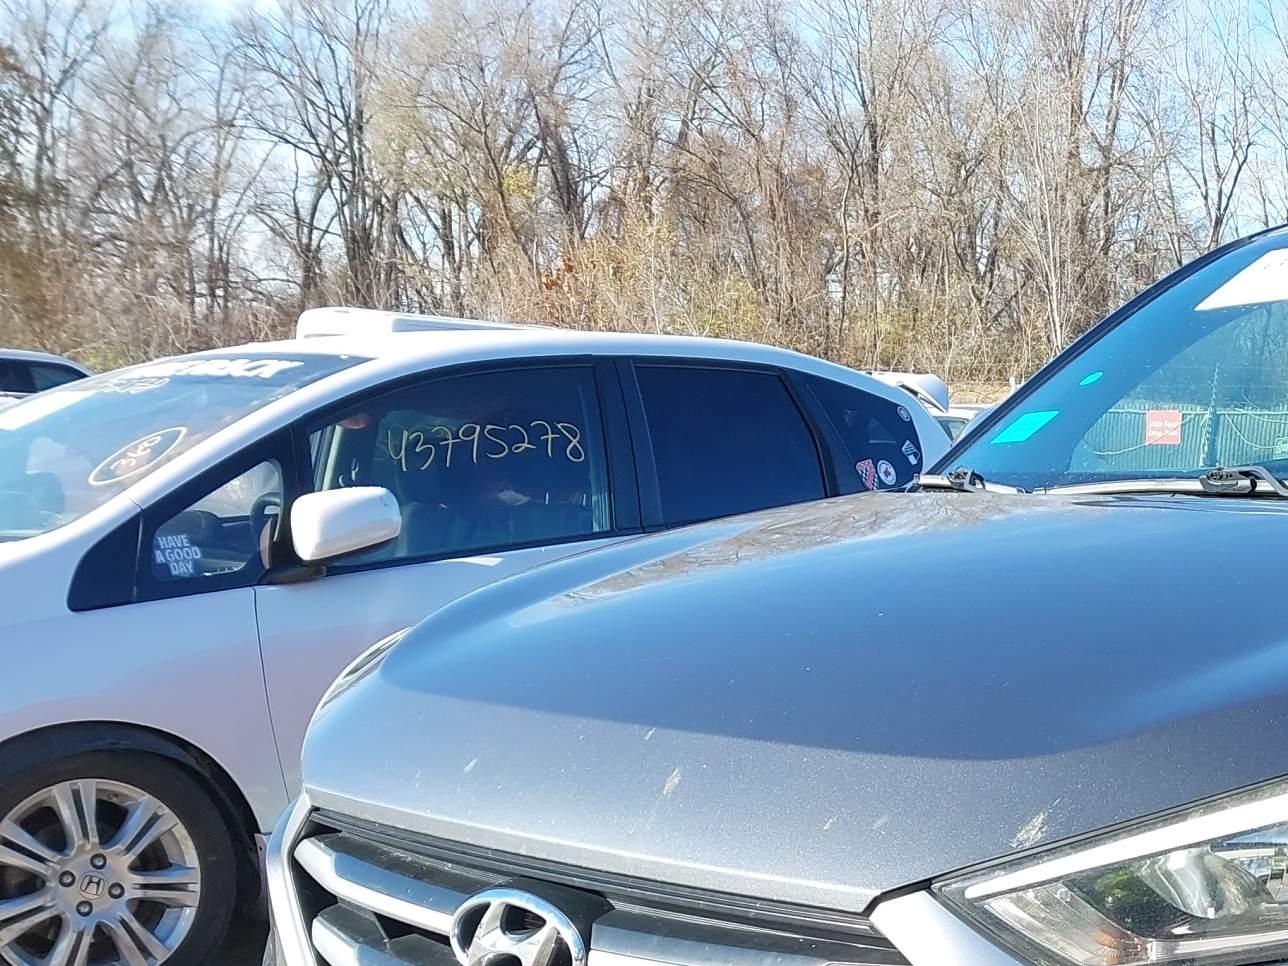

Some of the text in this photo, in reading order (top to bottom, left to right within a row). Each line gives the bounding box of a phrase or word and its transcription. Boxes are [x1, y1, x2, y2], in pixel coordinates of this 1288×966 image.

[386, 420, 585, 472] 43795278
[158, 534, 190, 548] HAVE
[155, 546, 201, 563] A GOOD
[169, 560, 193, 575] DAY
